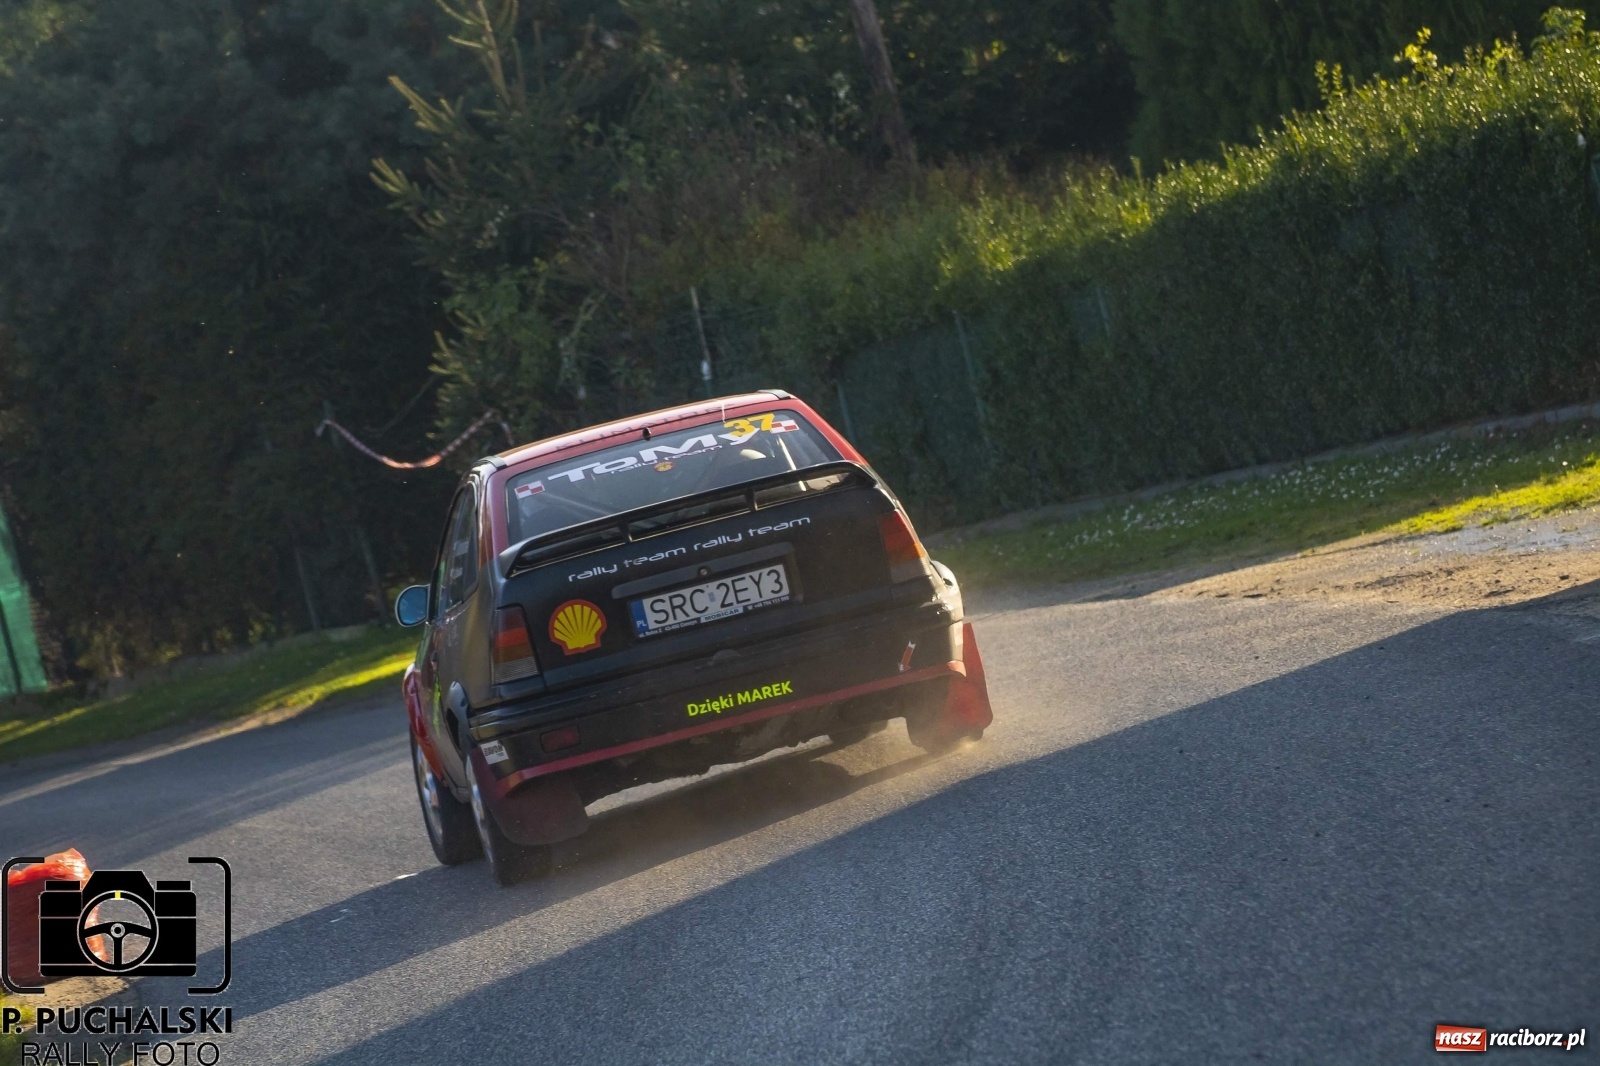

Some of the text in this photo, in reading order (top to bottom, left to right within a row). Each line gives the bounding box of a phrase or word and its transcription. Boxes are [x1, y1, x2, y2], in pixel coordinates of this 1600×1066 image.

[723, 412, 776, 438] 37
[609, 458, 658, 475] rally
[568, 515, 811, 582] rally team rally team
[649, 569, 784, 625] SRC 2EY3
[636, 620, 647, 629] PL
[704, 608, 740, 621] MOBICAR
[687, 681, 793, 717] Dzięki MAREK
